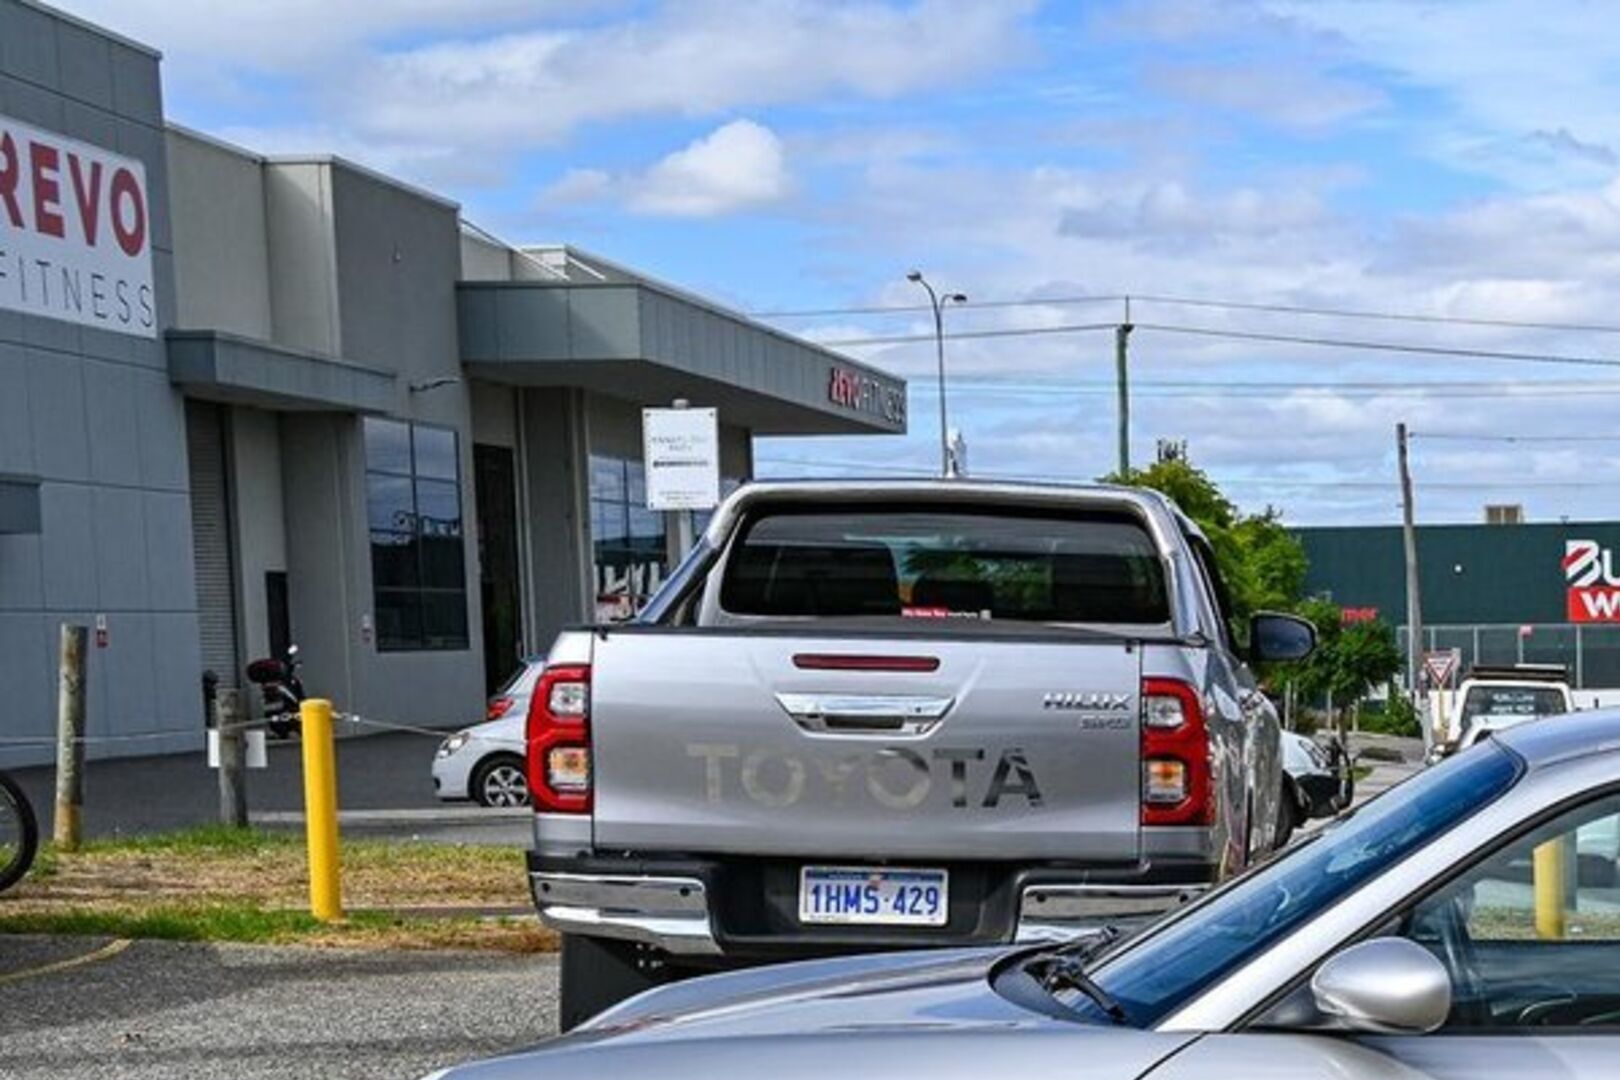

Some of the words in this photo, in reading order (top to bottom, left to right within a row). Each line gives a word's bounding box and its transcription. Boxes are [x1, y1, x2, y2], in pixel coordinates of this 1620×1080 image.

[0, 131, 147, 257] REVO
[1043, 692, 1130, 711] HILUX
[687, 744, 1043, 810] TOYOTA
